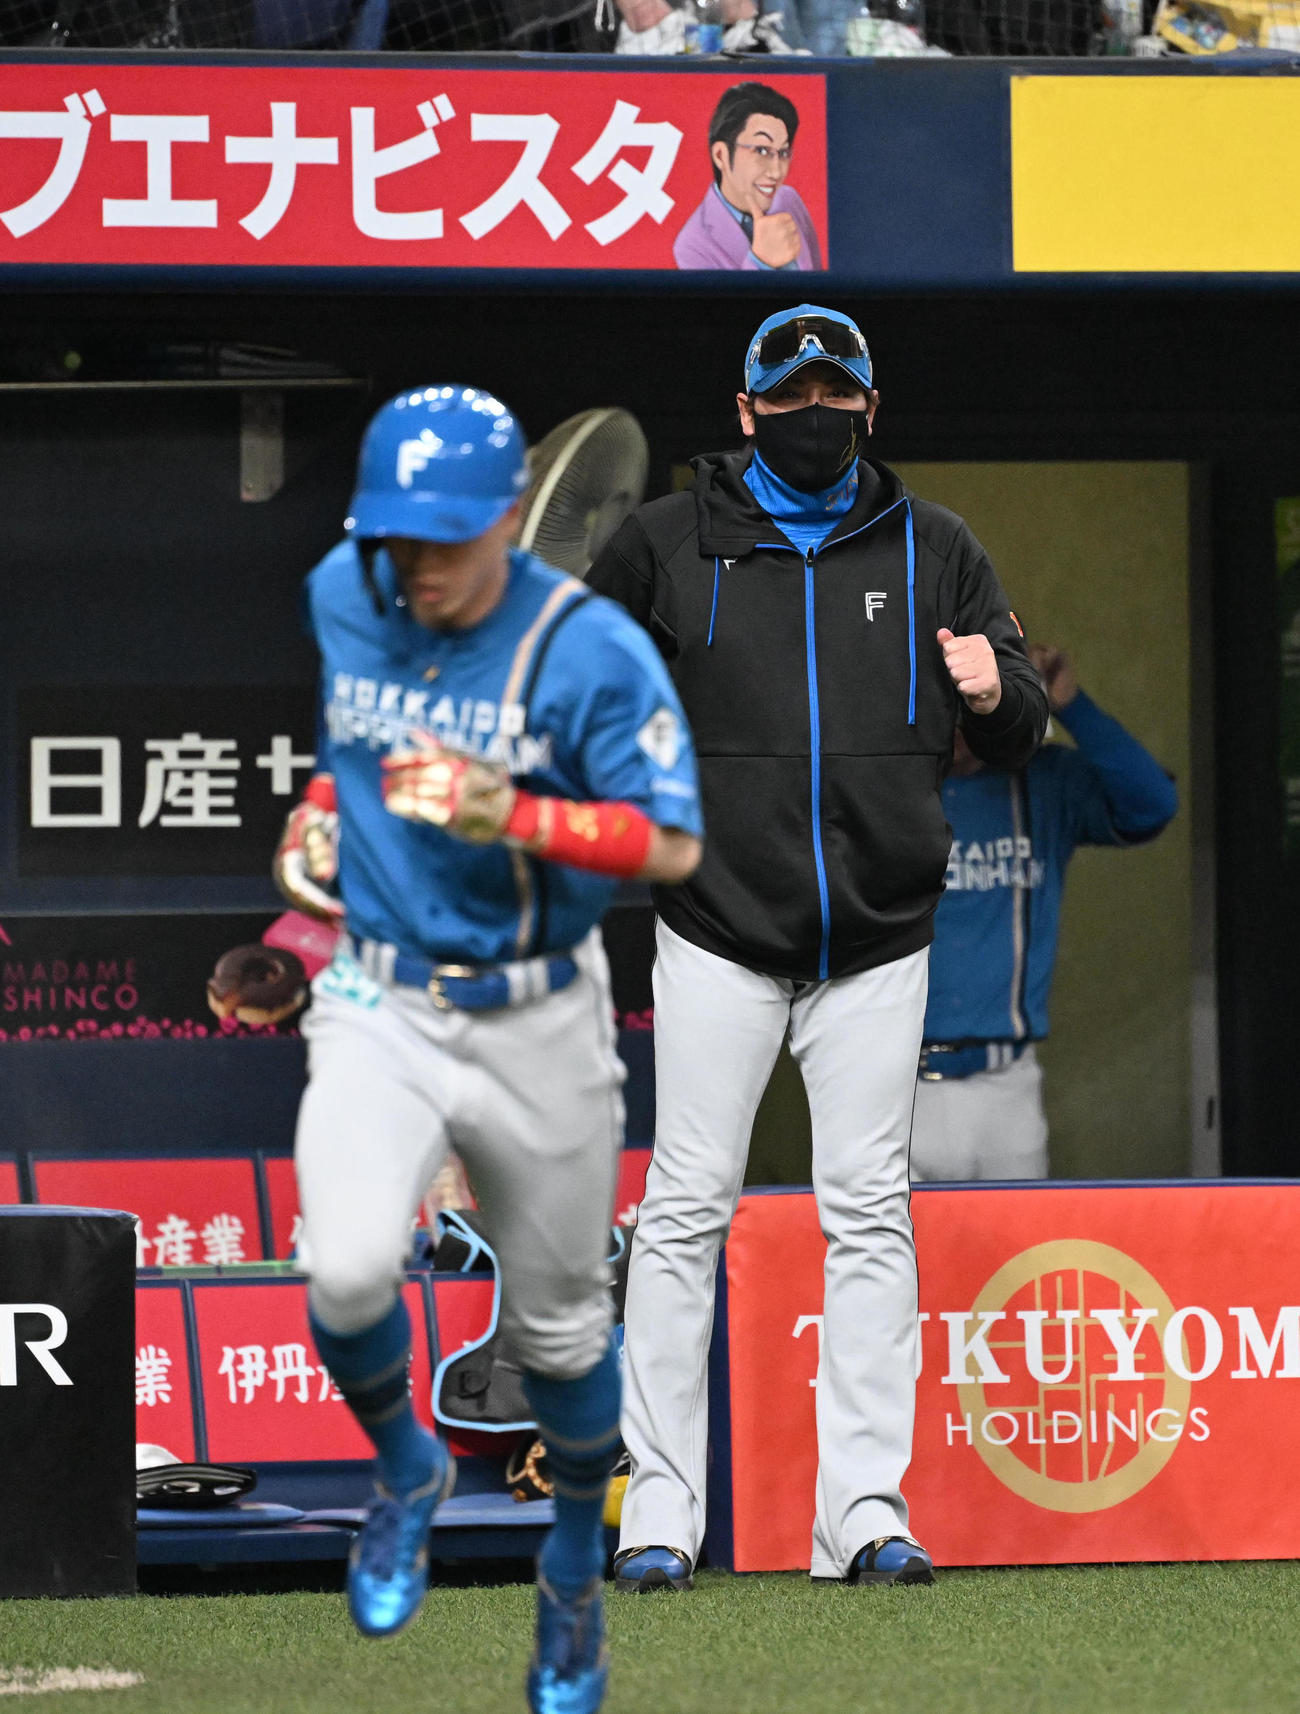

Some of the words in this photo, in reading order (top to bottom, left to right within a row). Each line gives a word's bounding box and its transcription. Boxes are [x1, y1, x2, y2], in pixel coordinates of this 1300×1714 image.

[0, 88, 684, 246] ブエナビスタ
[865, 592, 888, 622] F
[3, 960, 137, 983] MADAME
[3, 984, 139, 1012] SHINCO
[945, 1407, 1211, 1446] HOLDINGS
